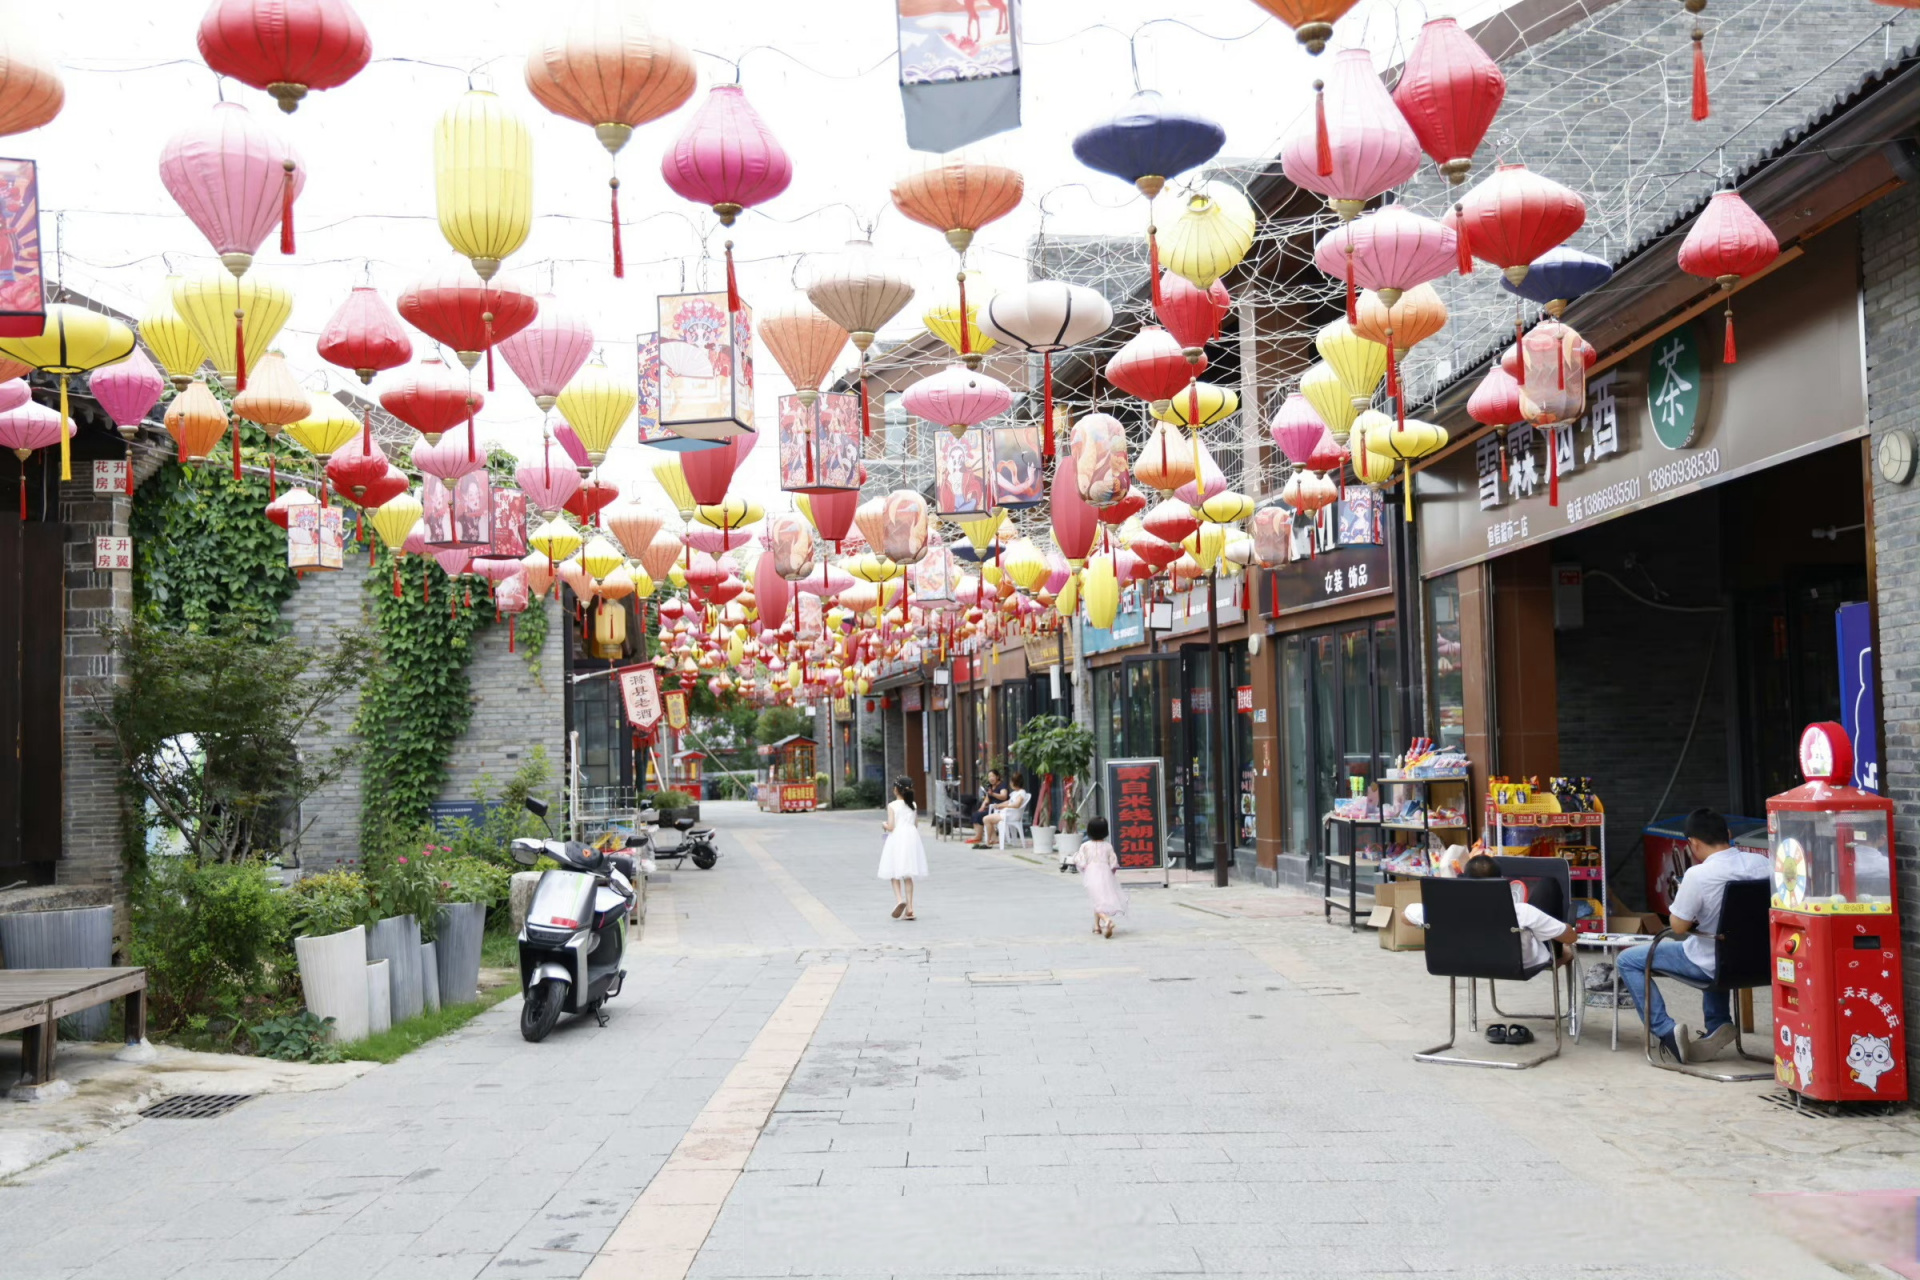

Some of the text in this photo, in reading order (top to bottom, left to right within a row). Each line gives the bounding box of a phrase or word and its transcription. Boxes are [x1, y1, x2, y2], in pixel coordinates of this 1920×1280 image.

[1655, 338, 1693, 427] 茶
[1566, 448, 1720, 523] 电话 13866935501 13866938530
[1487, 515, 1528, 548] 恒信超市二店
[1324, 563, 1368, 594] 女装 饰品
